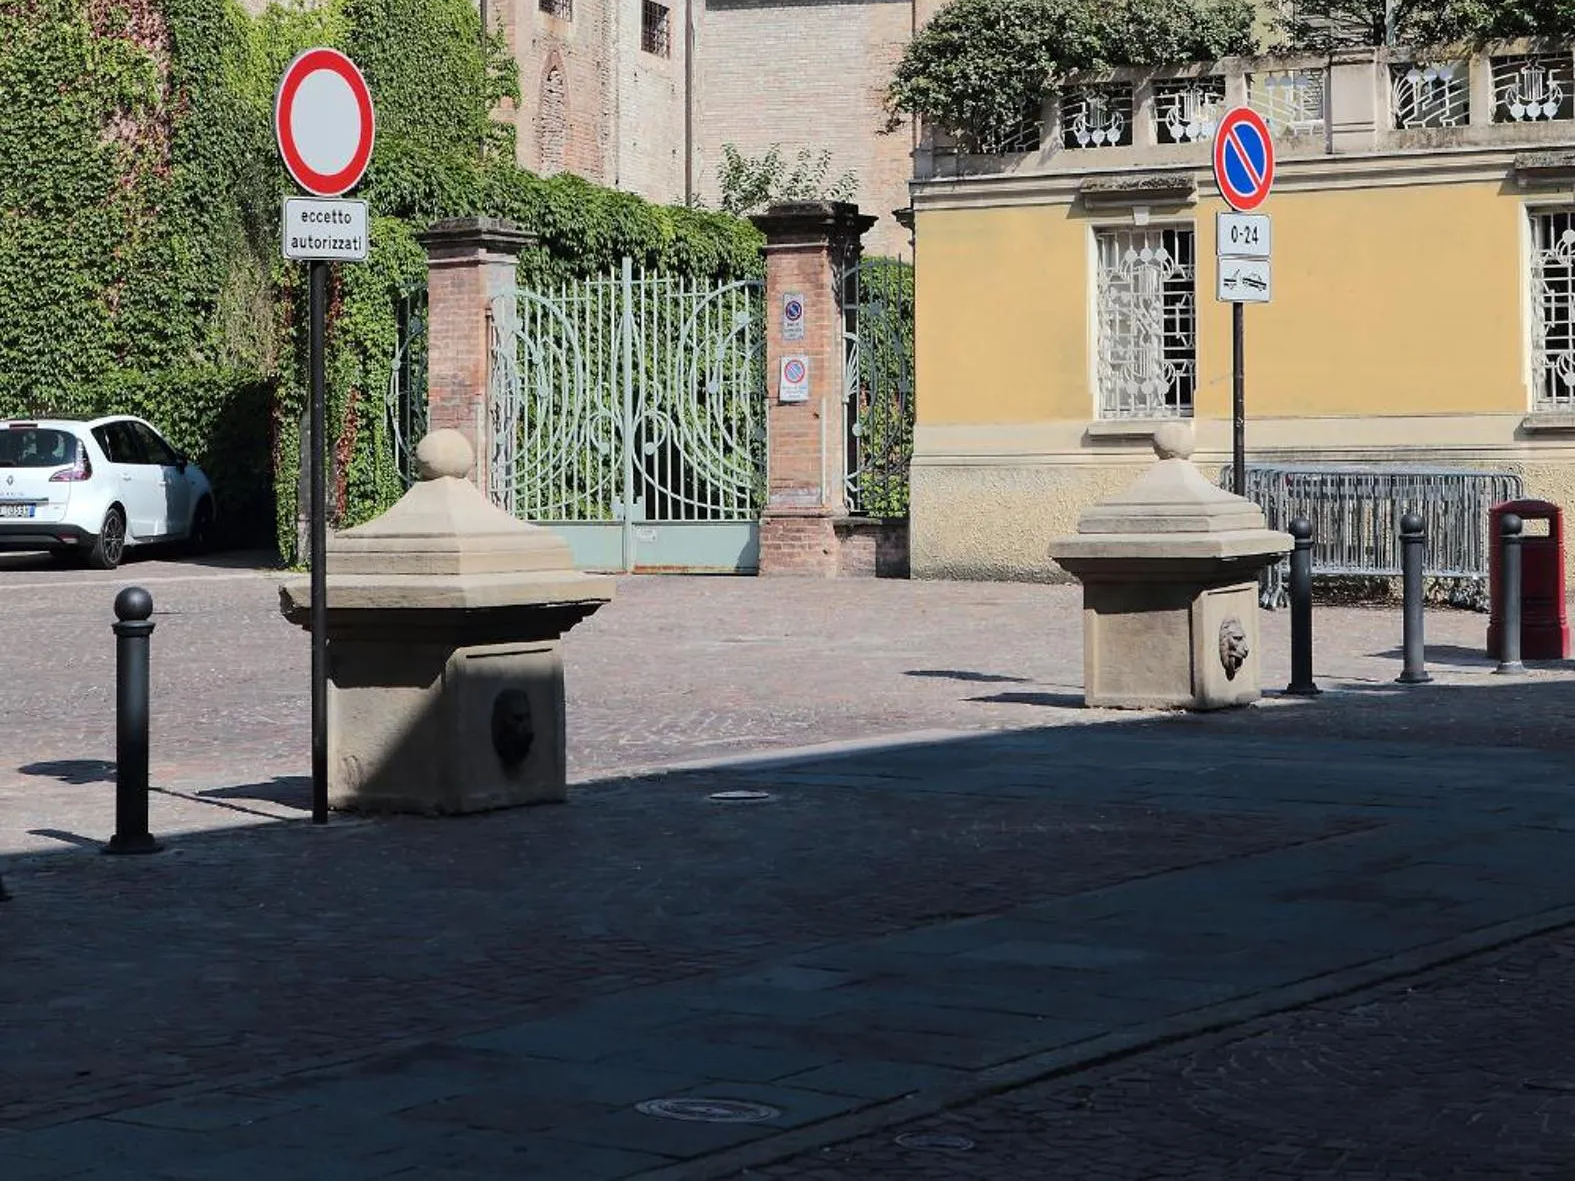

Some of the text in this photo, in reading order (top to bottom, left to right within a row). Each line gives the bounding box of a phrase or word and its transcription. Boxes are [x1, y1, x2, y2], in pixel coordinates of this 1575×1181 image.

[301, 209, 352, 224] eccetto
[291, 234, 362, 251] autorizzati
[1231, 225, 1259, 245] 0-24
